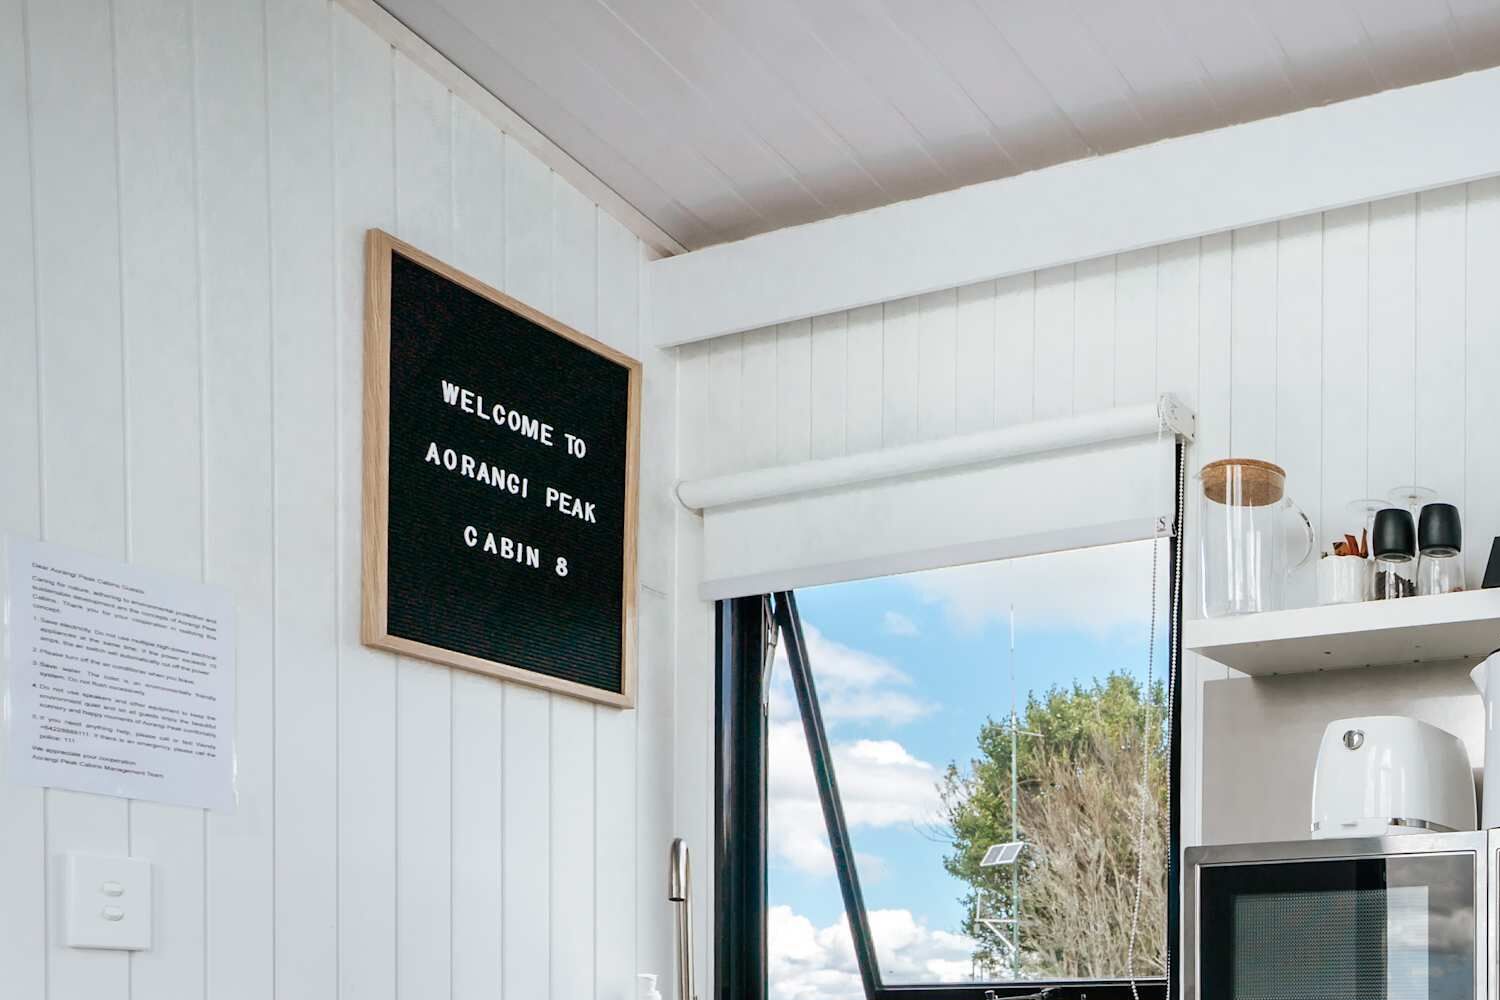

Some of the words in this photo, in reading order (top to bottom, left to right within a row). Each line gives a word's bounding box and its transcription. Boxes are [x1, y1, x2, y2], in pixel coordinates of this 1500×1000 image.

[441, 379, 554, 447] WELCOME
[564, 433, 587, 459] TO
[425, 441, 528, 499] AORANGI
[545, 487, 597, 524] PEAK
[463, 525, 540, 569] CABIN
[555, 556, 569, 577] 8
